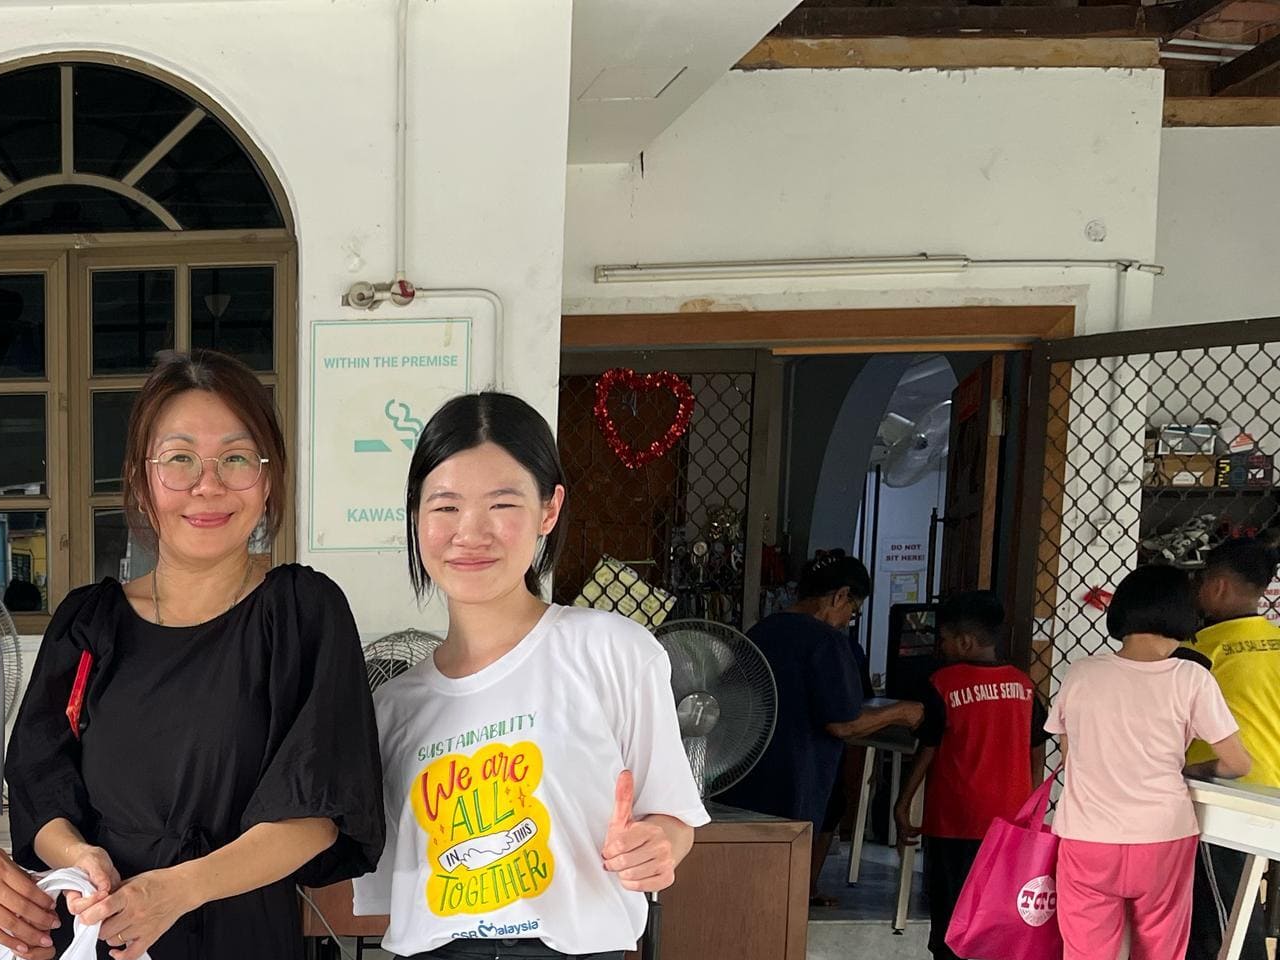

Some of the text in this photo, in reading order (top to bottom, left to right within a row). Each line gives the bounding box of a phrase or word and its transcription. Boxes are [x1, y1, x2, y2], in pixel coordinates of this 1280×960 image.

[324, 355, 458, 369] WITHIN THE PREMISE
[949, 690, 961, 708] SK
[961, 687, 974, 705] LA
[974, 683, 1000, 701] SALLE
[417, 712, 537, 761] SUSTAINABILITY
[421, 752, 529, 821] We are
[450, 780, 515, 841] ALL
[436, 850, 548, 912] TOGETHER
[446, 849, 460, 867] IN
